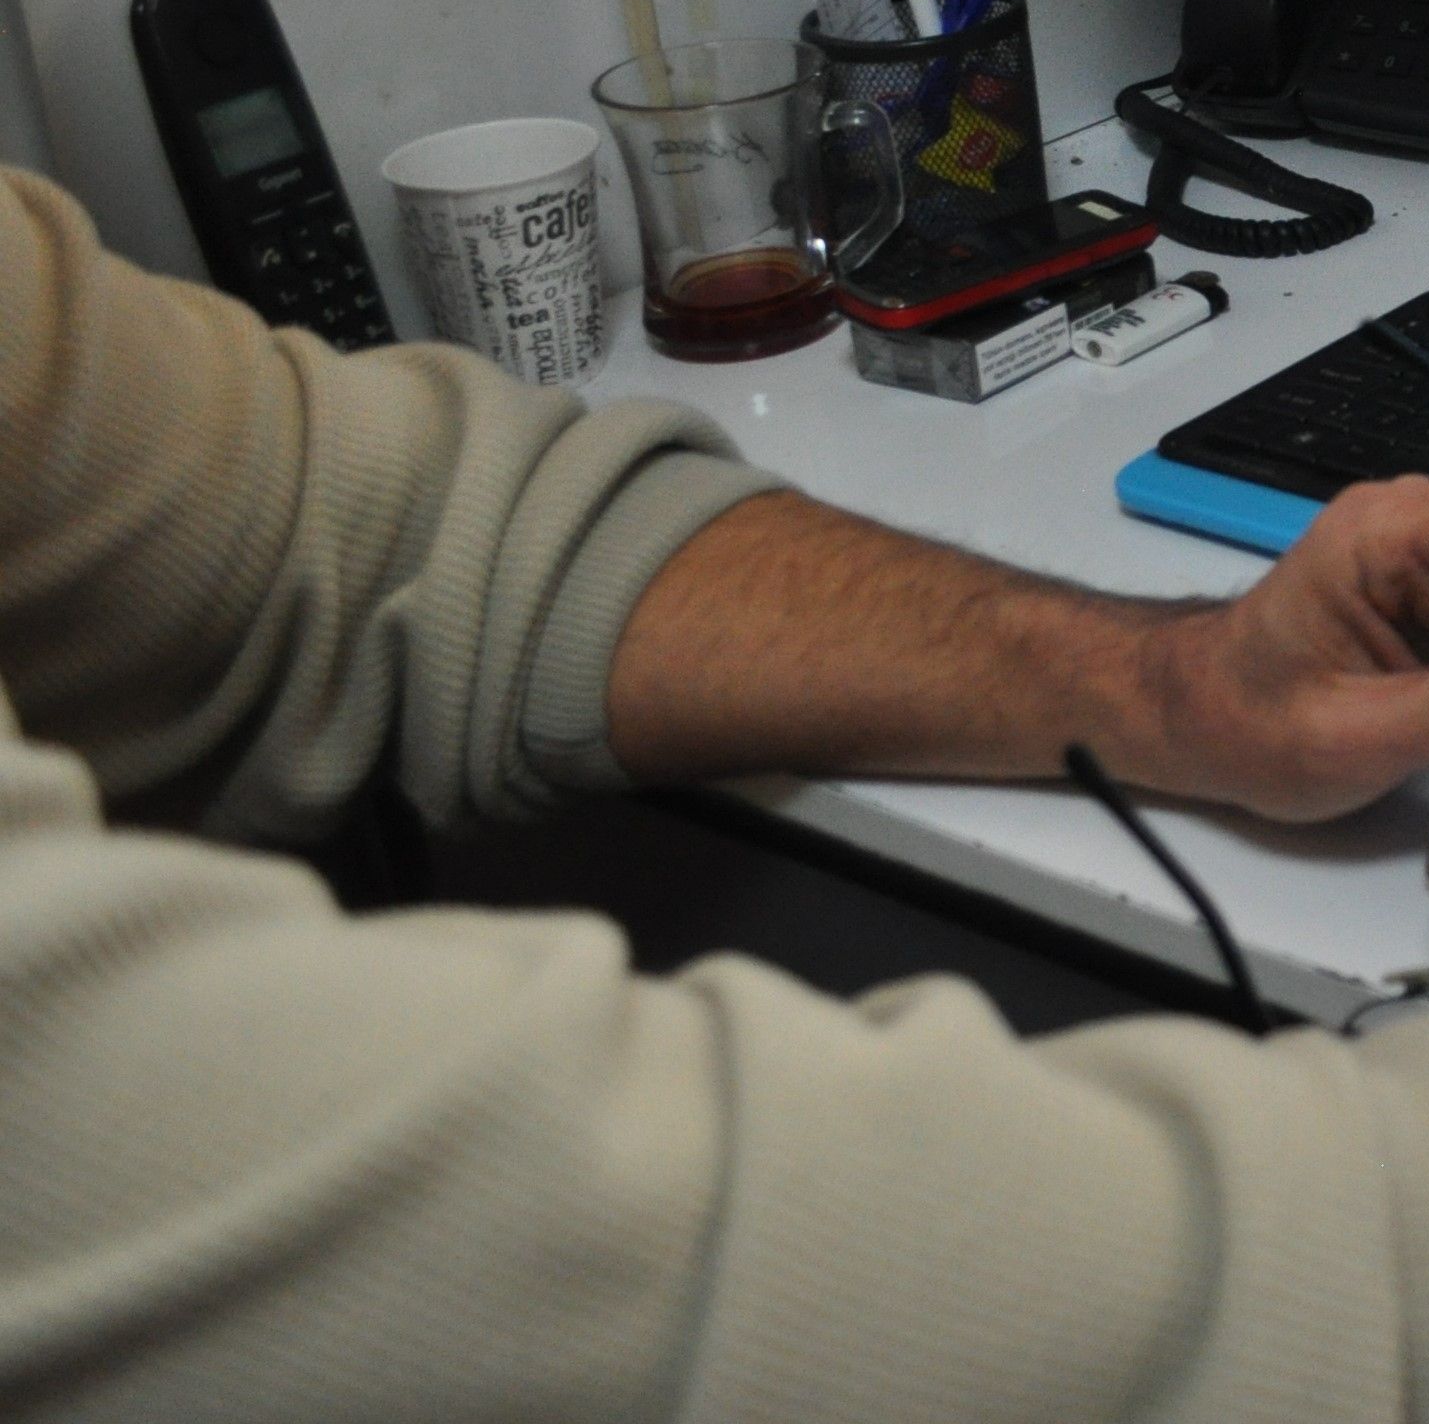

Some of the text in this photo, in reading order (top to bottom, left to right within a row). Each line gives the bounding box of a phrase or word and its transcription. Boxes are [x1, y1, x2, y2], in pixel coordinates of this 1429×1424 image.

[522, 189, 591, 248] cafe
[507, 307, 550, 330] tea
[529, 328, 558, 386] mocha
